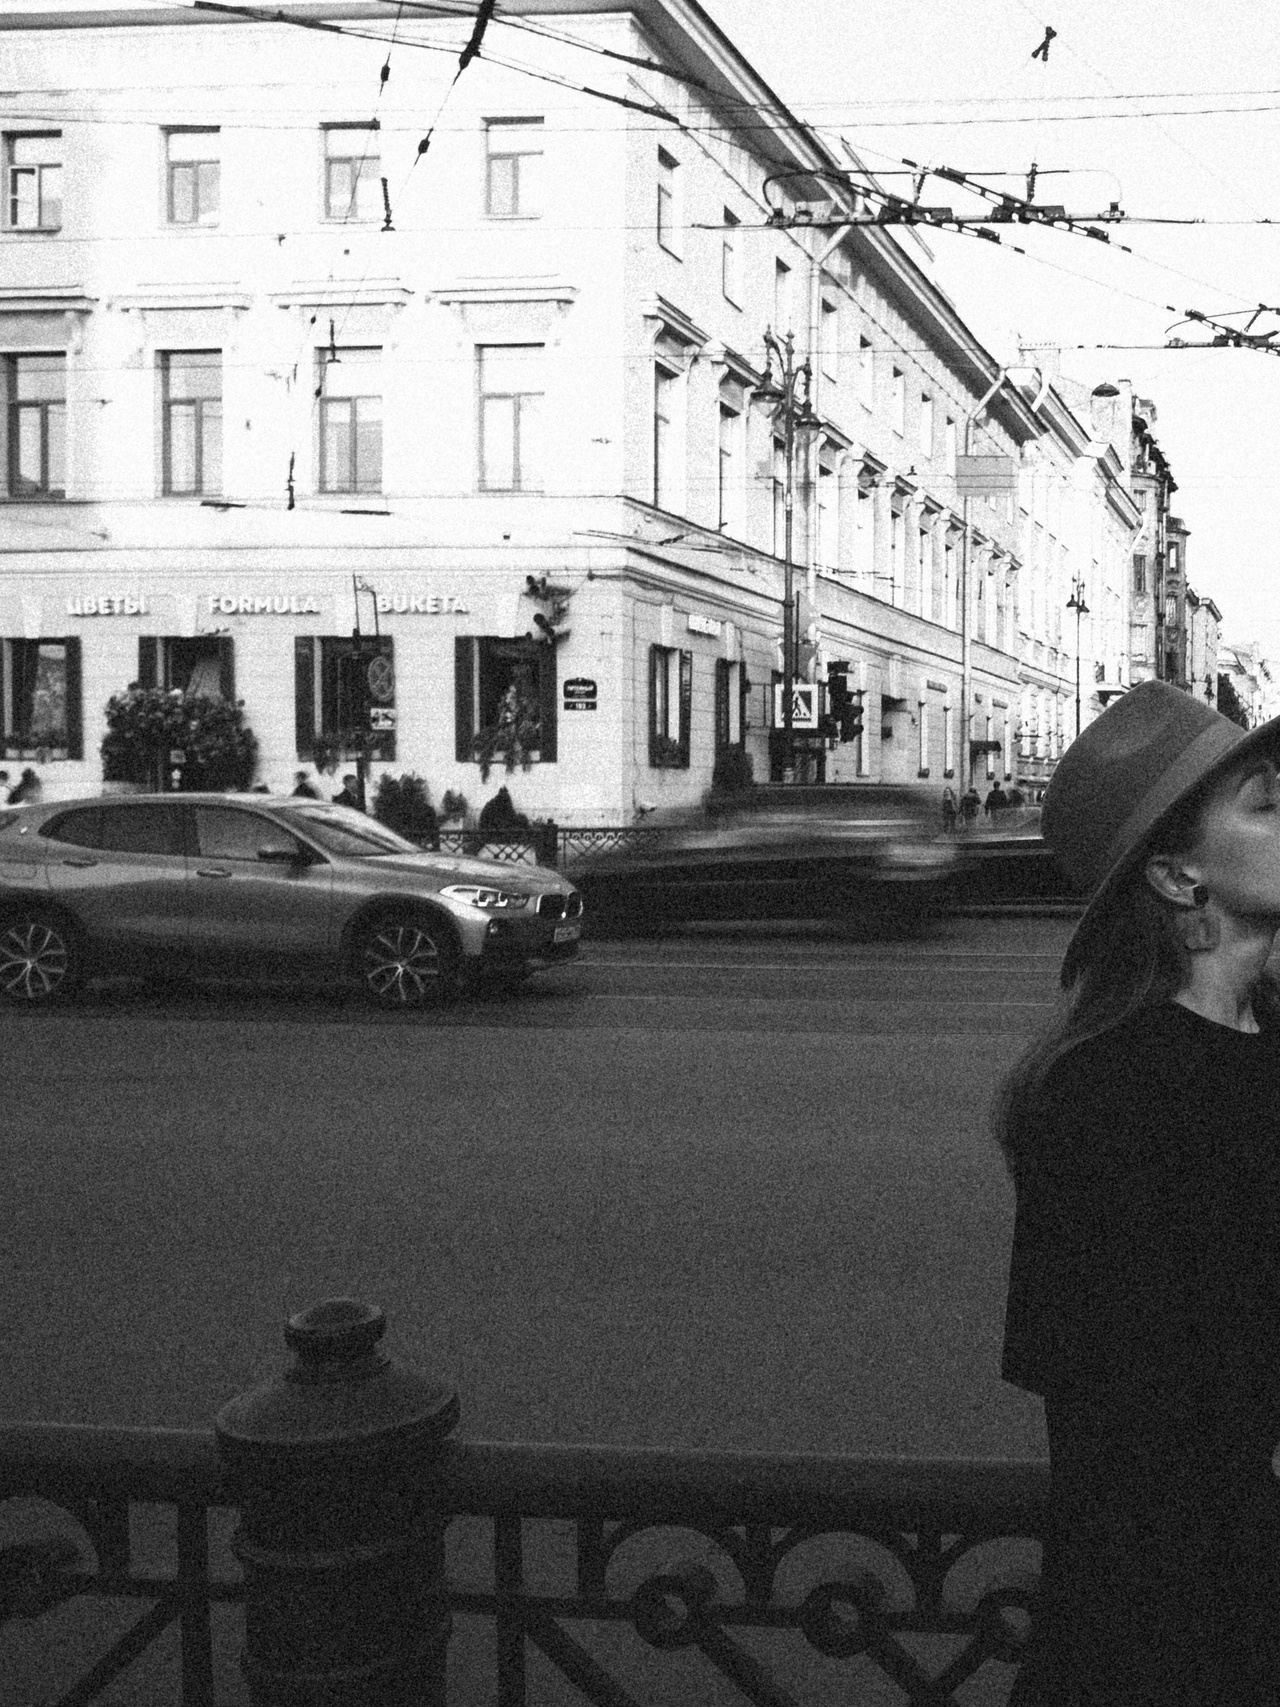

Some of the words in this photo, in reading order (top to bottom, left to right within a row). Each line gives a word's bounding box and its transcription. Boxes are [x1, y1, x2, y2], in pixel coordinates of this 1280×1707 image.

[67, 595, 147, 618] ЦВЕТЫ
[208, 595, 320, 615] FORMULA
[378, 595, 470, 616] BUKETA
